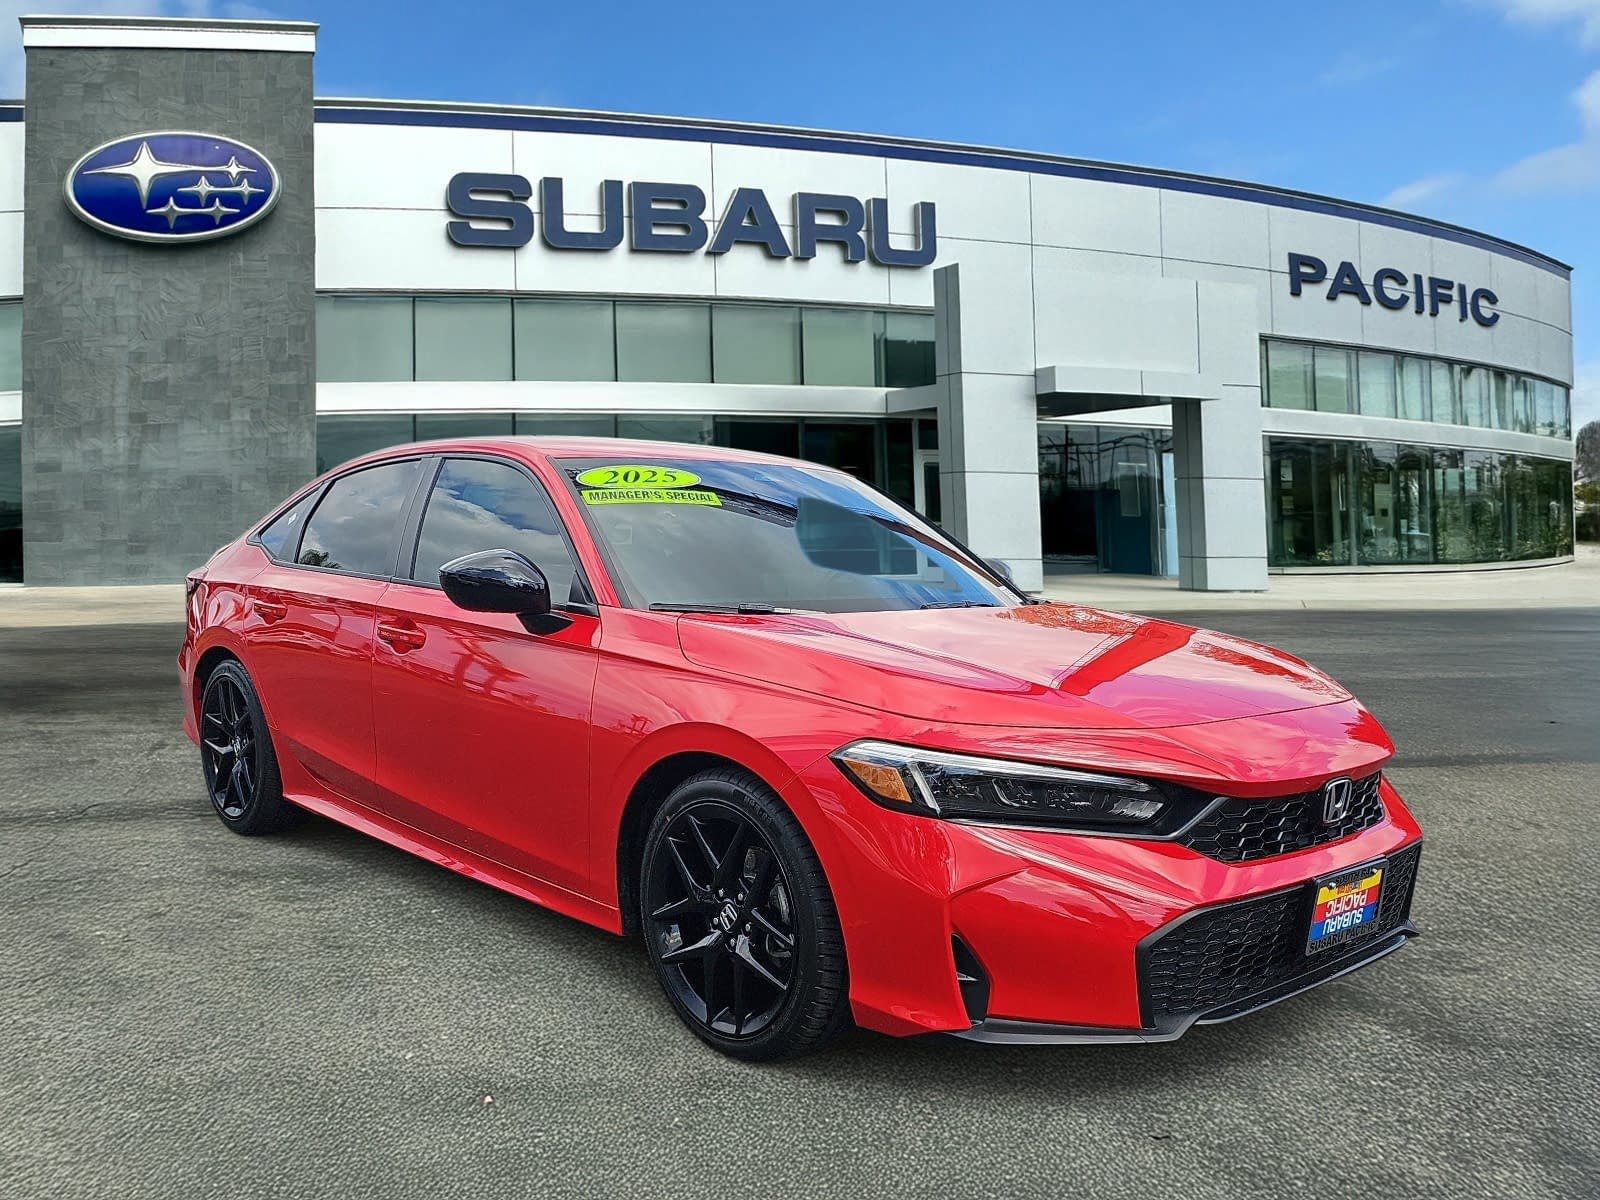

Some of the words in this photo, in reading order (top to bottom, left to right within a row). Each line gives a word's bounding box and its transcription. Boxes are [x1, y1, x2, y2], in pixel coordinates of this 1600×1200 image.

[446, 172, 937, 267] SUBARU
[1288, 252, 1500, 327] PACIFIC
[603, 470, 678, 485] 2025
[589, 490, 662, 501] MANAGER'S
[666, 491, 714, 502] SPECIAL
[1326, 890, 1368, 918] PACIFIC
[1322, 907, 1364, 935] SUBARU
[1309, 929, 1344, 952] SUBARU
